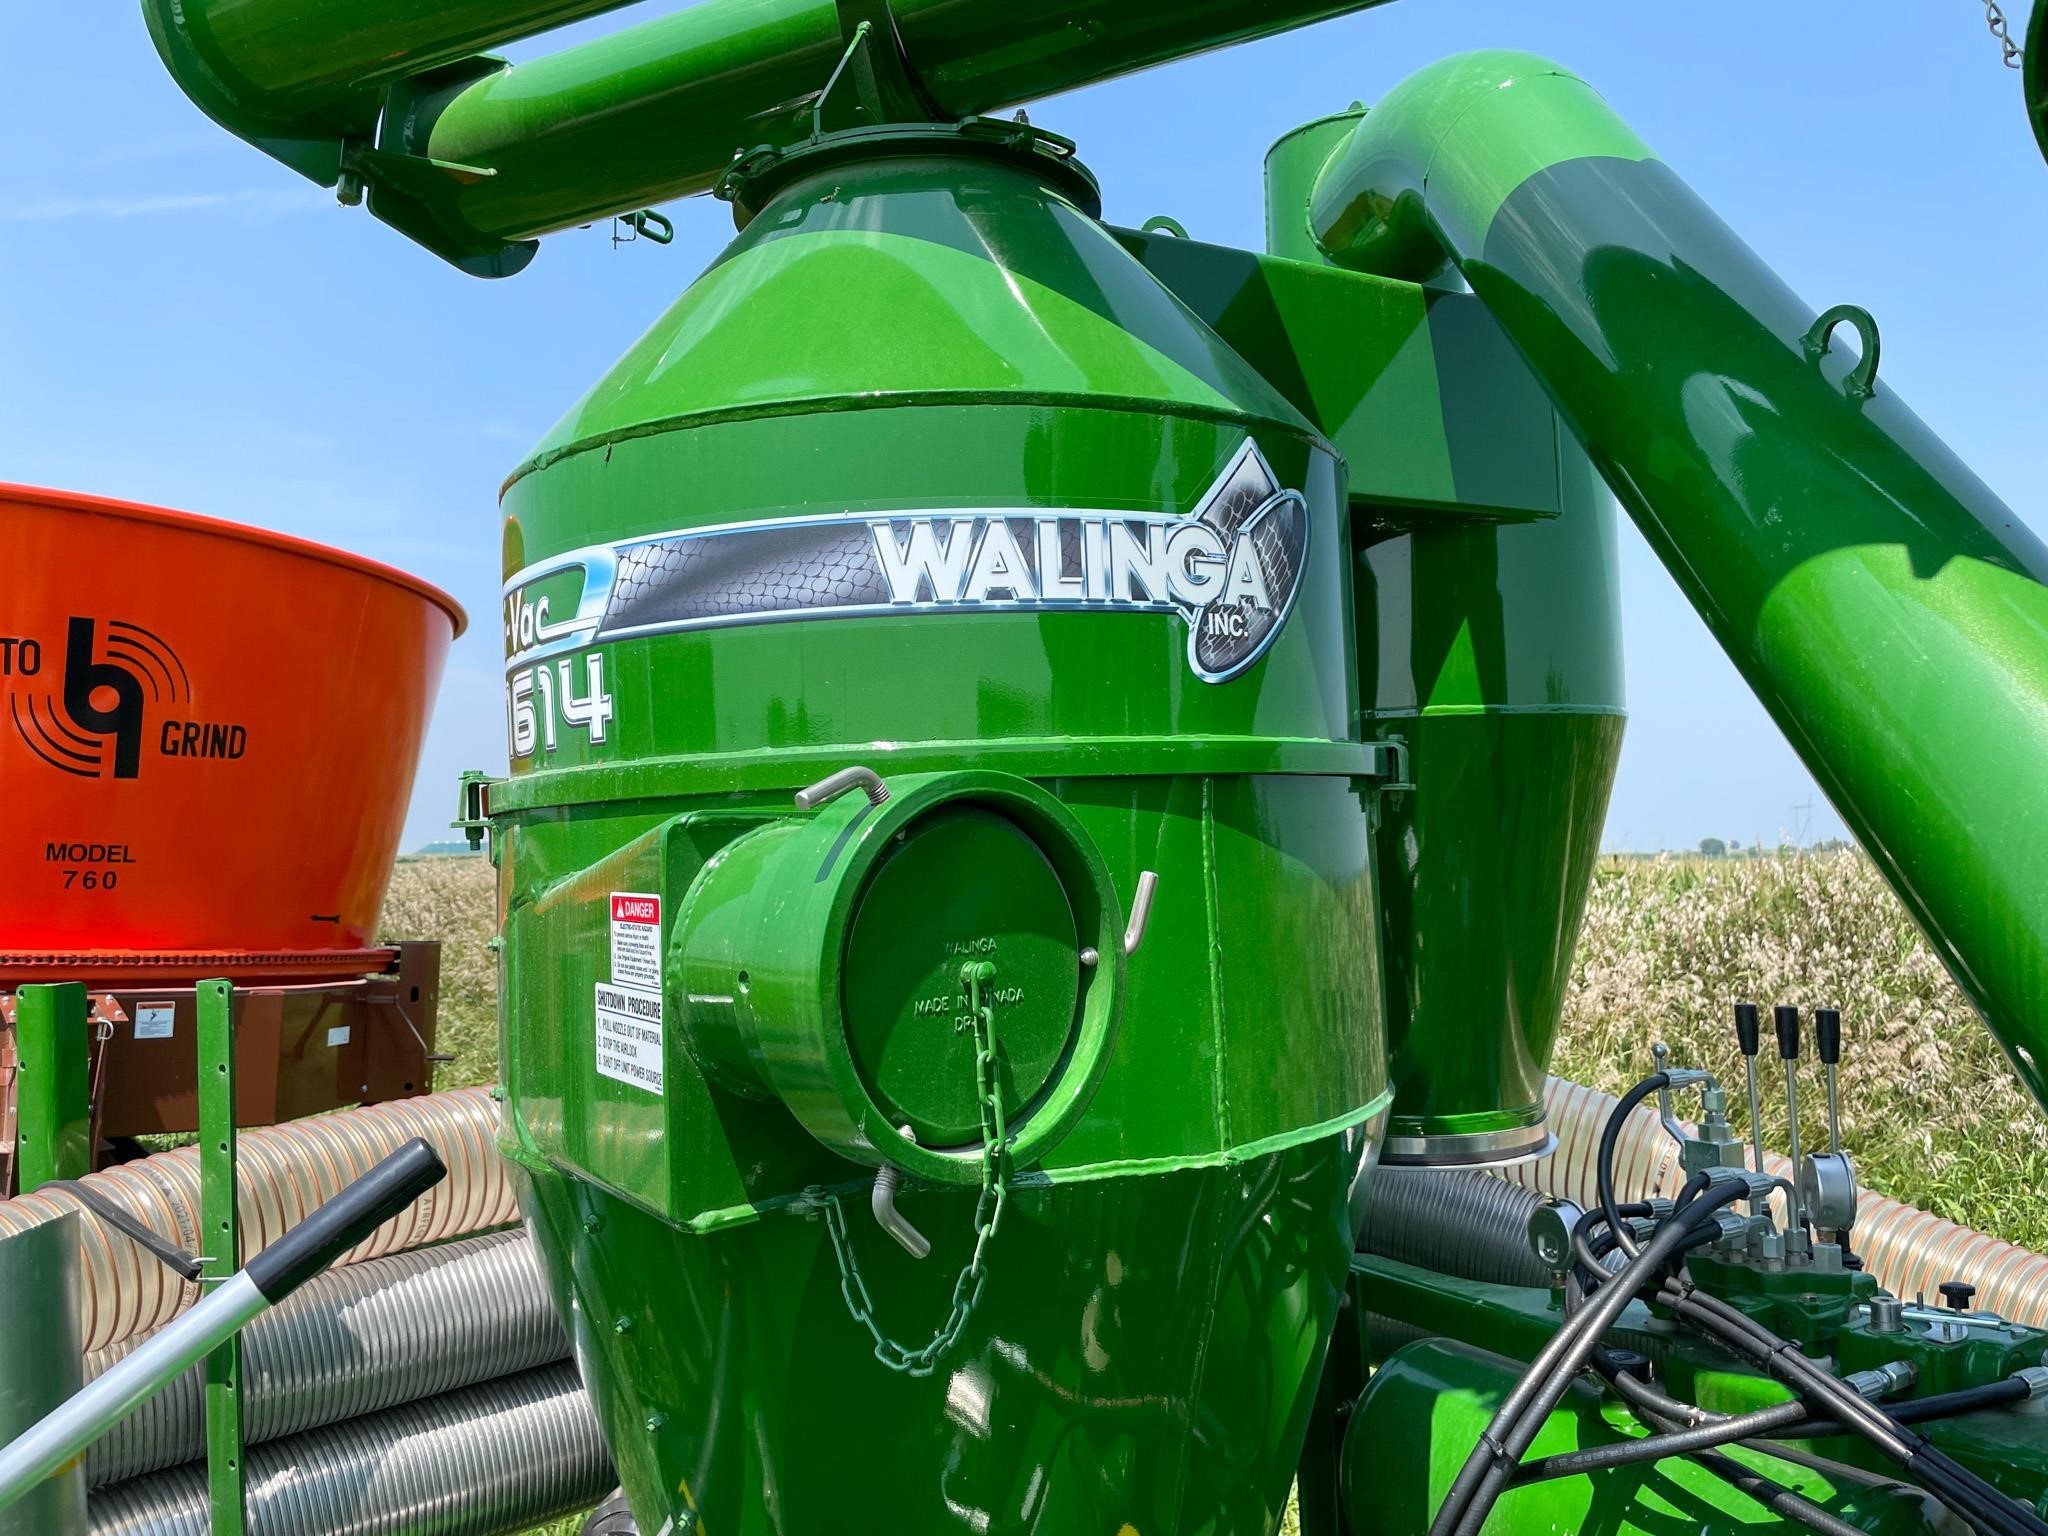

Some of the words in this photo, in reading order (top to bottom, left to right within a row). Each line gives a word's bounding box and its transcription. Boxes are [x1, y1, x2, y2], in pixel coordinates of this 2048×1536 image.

[868, 516, 1272, 611] WALINGA
[1208, 613, 1249, 637] INC.
[160, 720, 248, 760] GRIND
[46, 843, 136, 864] MODEL
[62, 870, 118, 890] 760
[625, 901, 654, 919] DANGER
[597, 989, 626, 1012] SHUTDOWN
[627, 996, 661, 1020] PROCEDURE
[914, 996, 950, 1015] MADE
[957, 994, 969, 1009] IN
[603, 1018, 613, 1033] PULL
[613, 1021, 627, 1036] NOZZLE
[627, 1025, 635, 1038] OUT
[636, 1027, 642, 1040] OF
[642, 1028, 662, 1046] MATERIAL
[603, 1037, 613, 1051] STOP
[613, 1039, 621, 1053] THE
[621, 1042, 638, 1058] AIRLOCK
[603, 1055, 614, 1069] SHUT
[621, 1061, 631, 1074] UNIT
[631, 1063, 646, 1080] POWER
[646, 1068, 663, 1087] SOURCE
